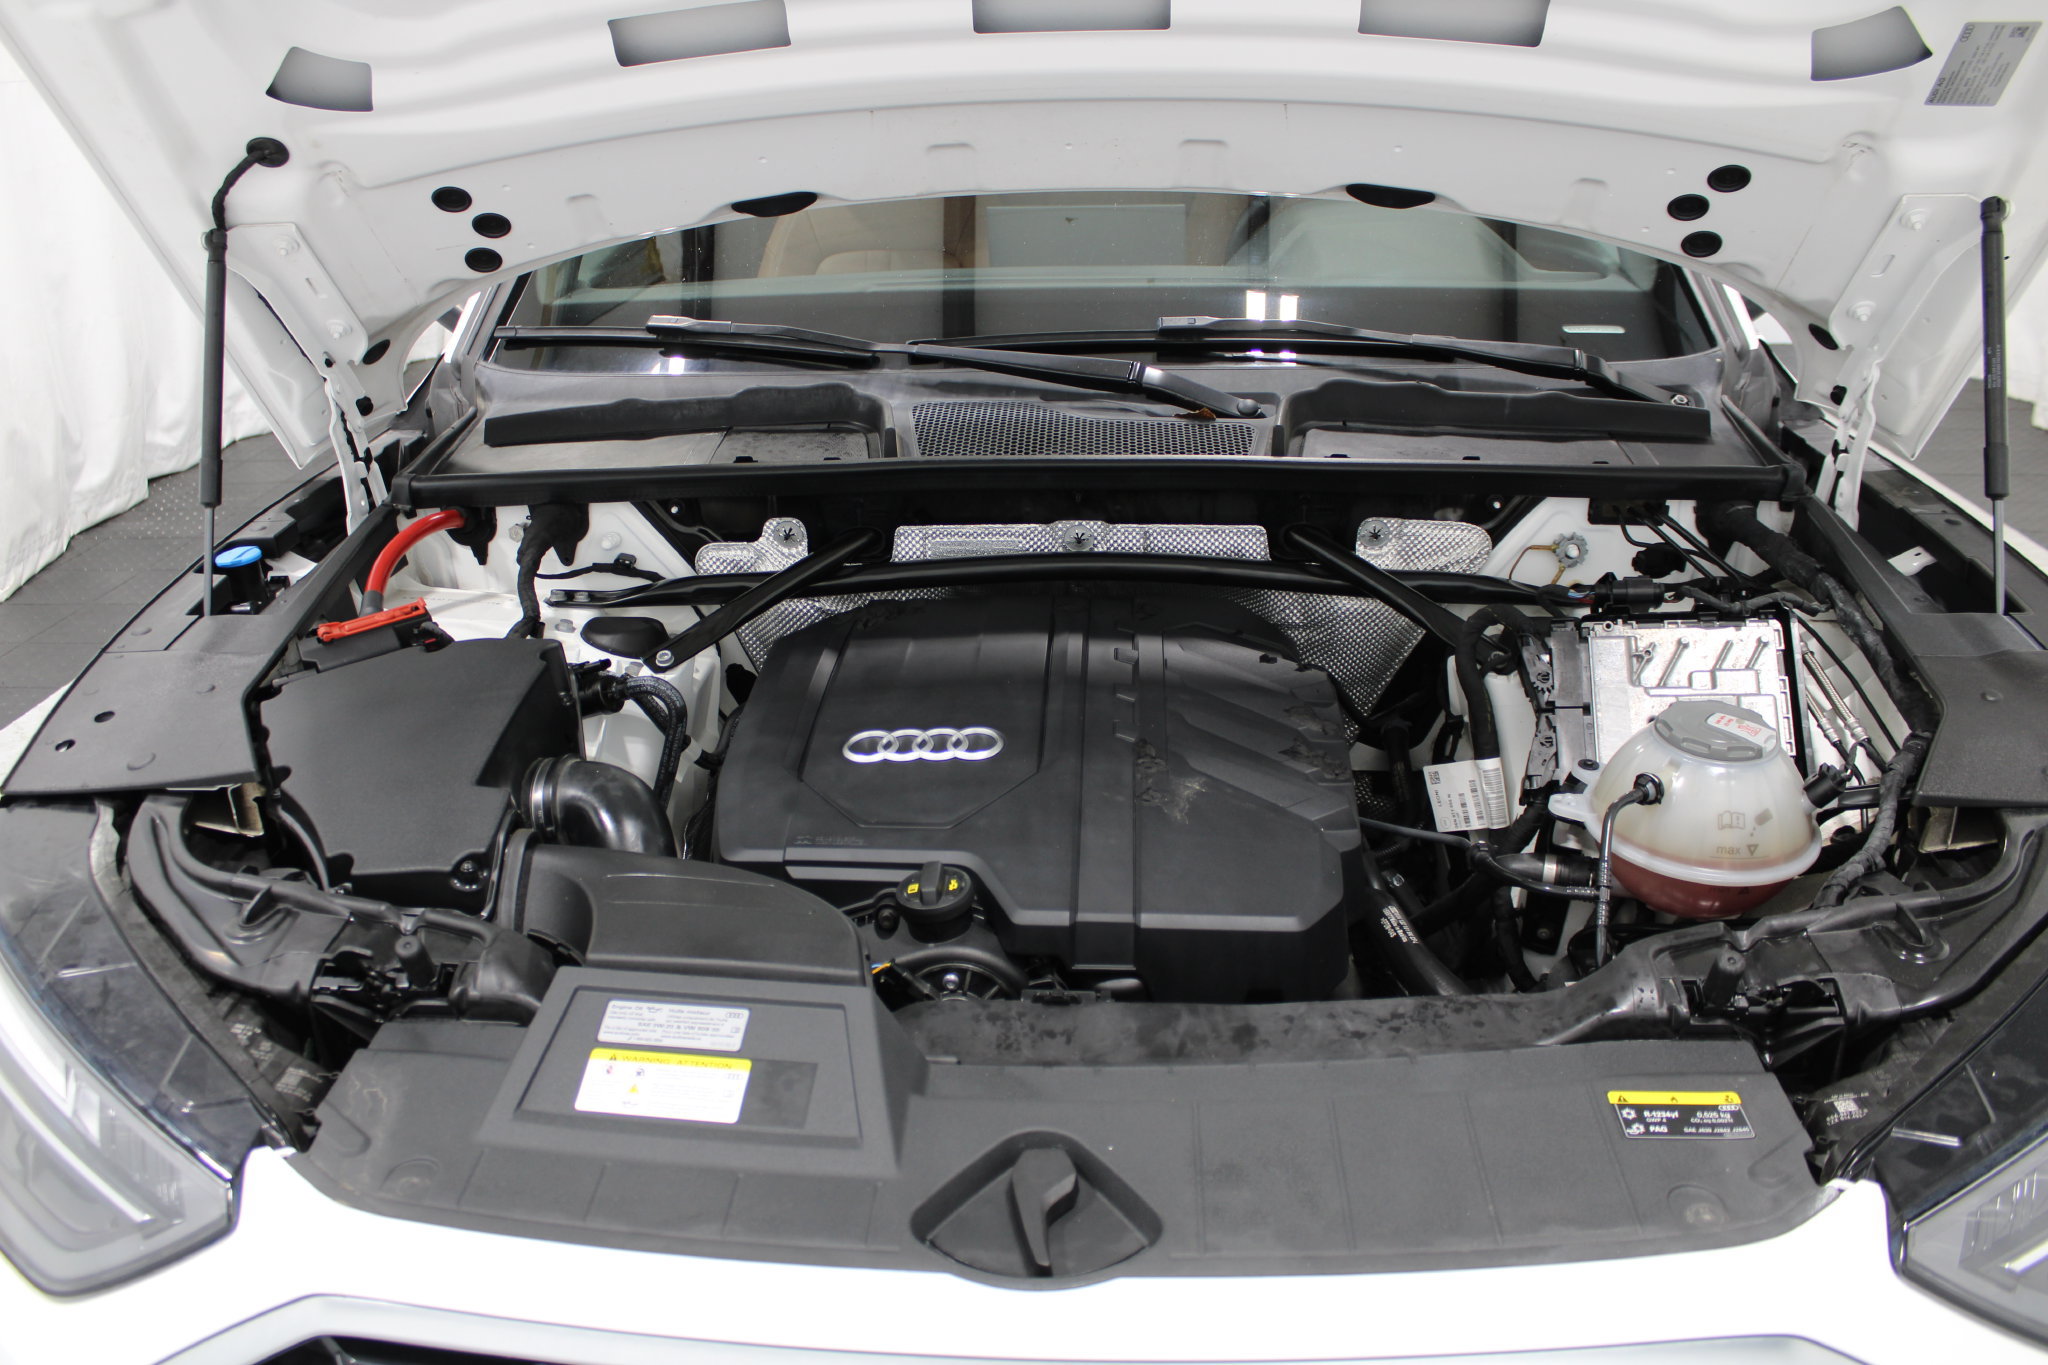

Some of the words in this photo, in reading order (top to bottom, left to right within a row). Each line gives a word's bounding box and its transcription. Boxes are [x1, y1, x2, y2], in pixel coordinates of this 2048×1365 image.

[1434, 789, 1442, 807] LEONI
[1716, 845, 1741, 856] max
[611, 1004, 632, 1012] Engine
[677, 1059, 732, 1069] ATTENTION
[1720, 1111, 1731, 1119] kg
[1650, 1125, 1668, 1133] PAG
